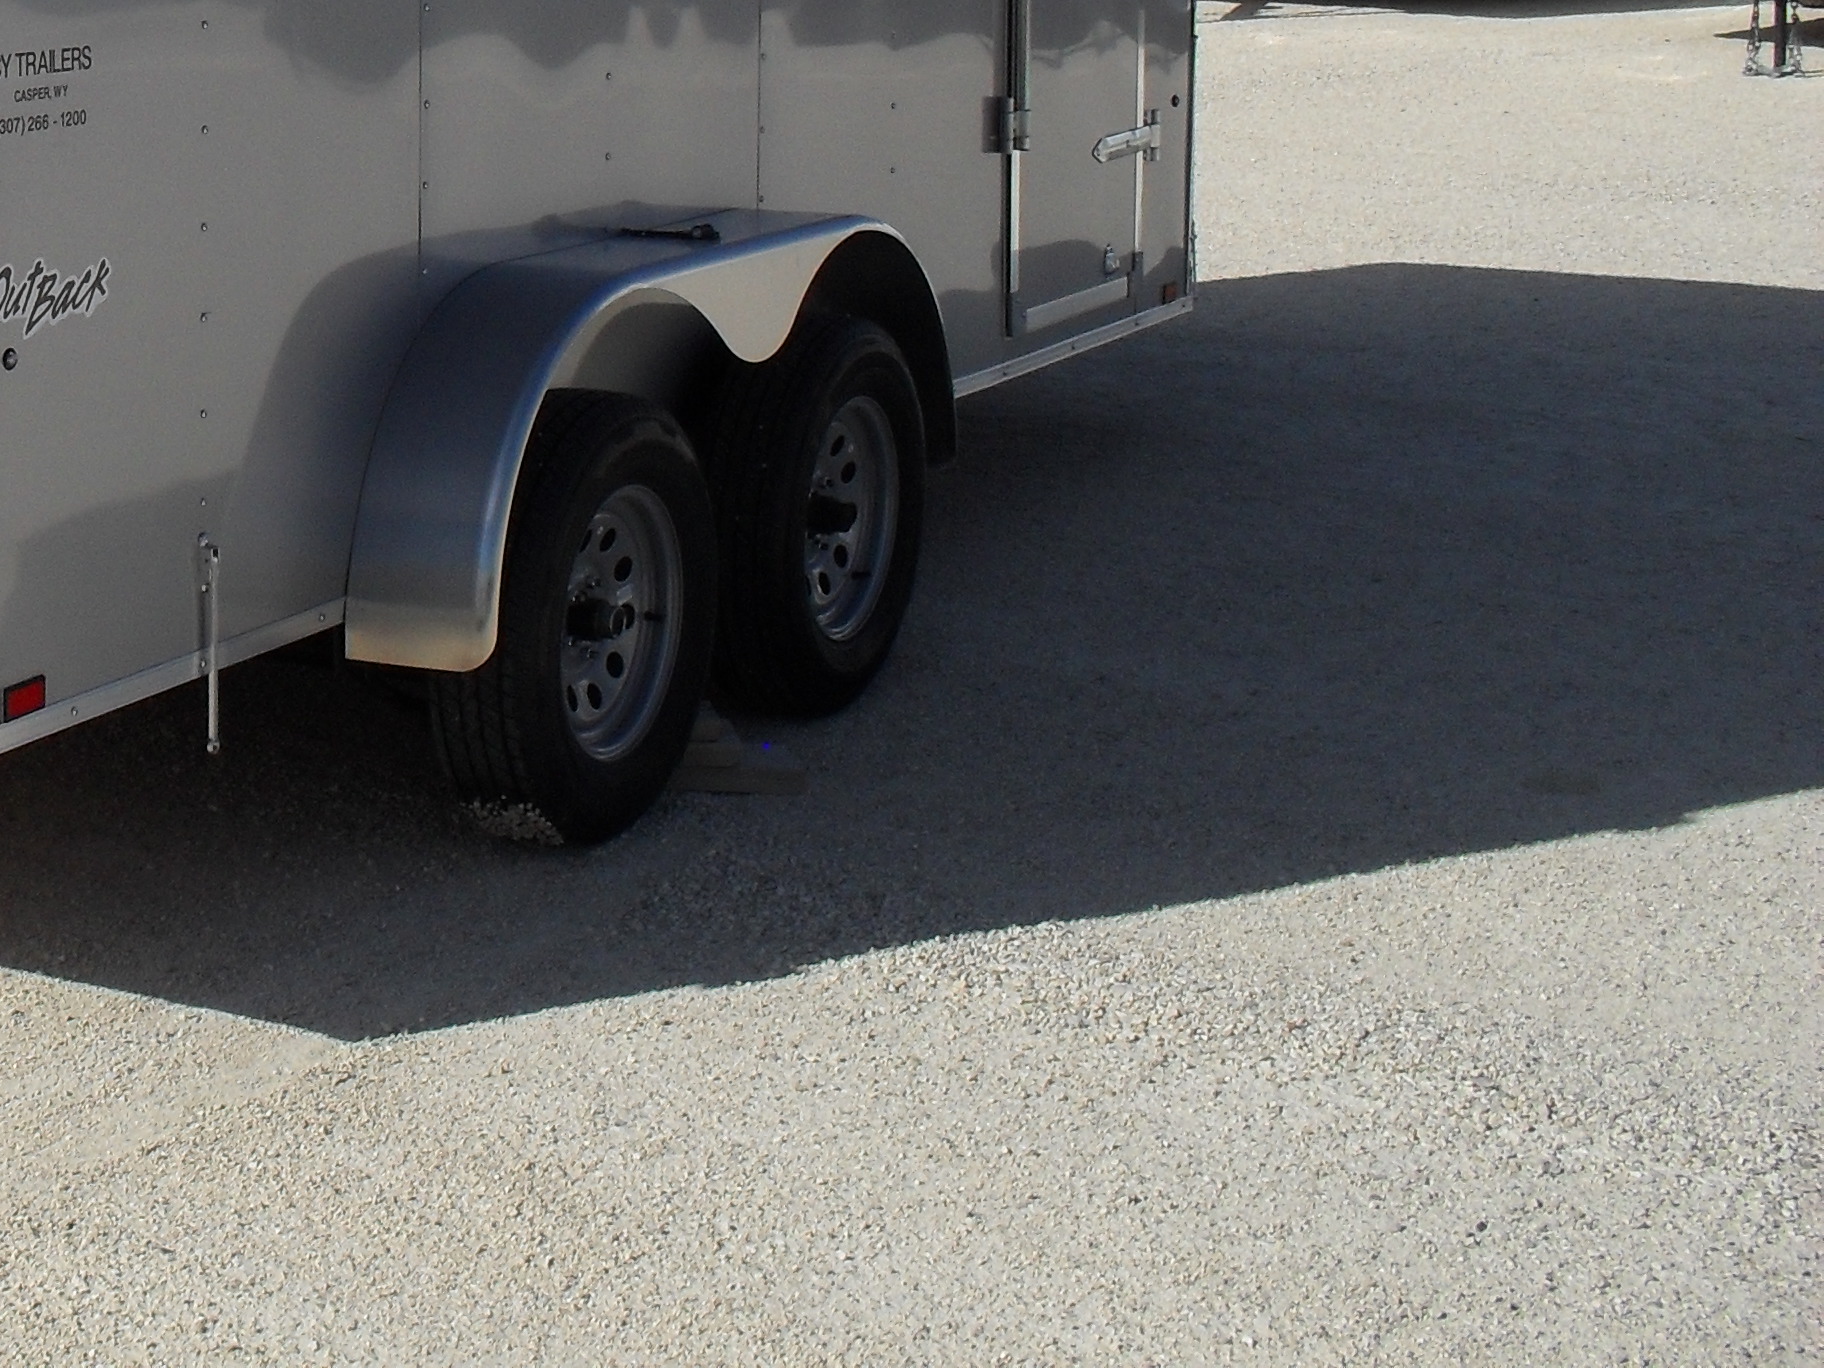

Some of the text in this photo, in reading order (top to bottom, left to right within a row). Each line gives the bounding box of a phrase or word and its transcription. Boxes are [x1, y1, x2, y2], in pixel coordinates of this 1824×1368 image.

[15, 45, 92, 77] TRAILERS
[14, 85, 69, 103] CASPER, WY
[27, 114, 49, 132] 266
[60, 109, 87, 127] 1200
